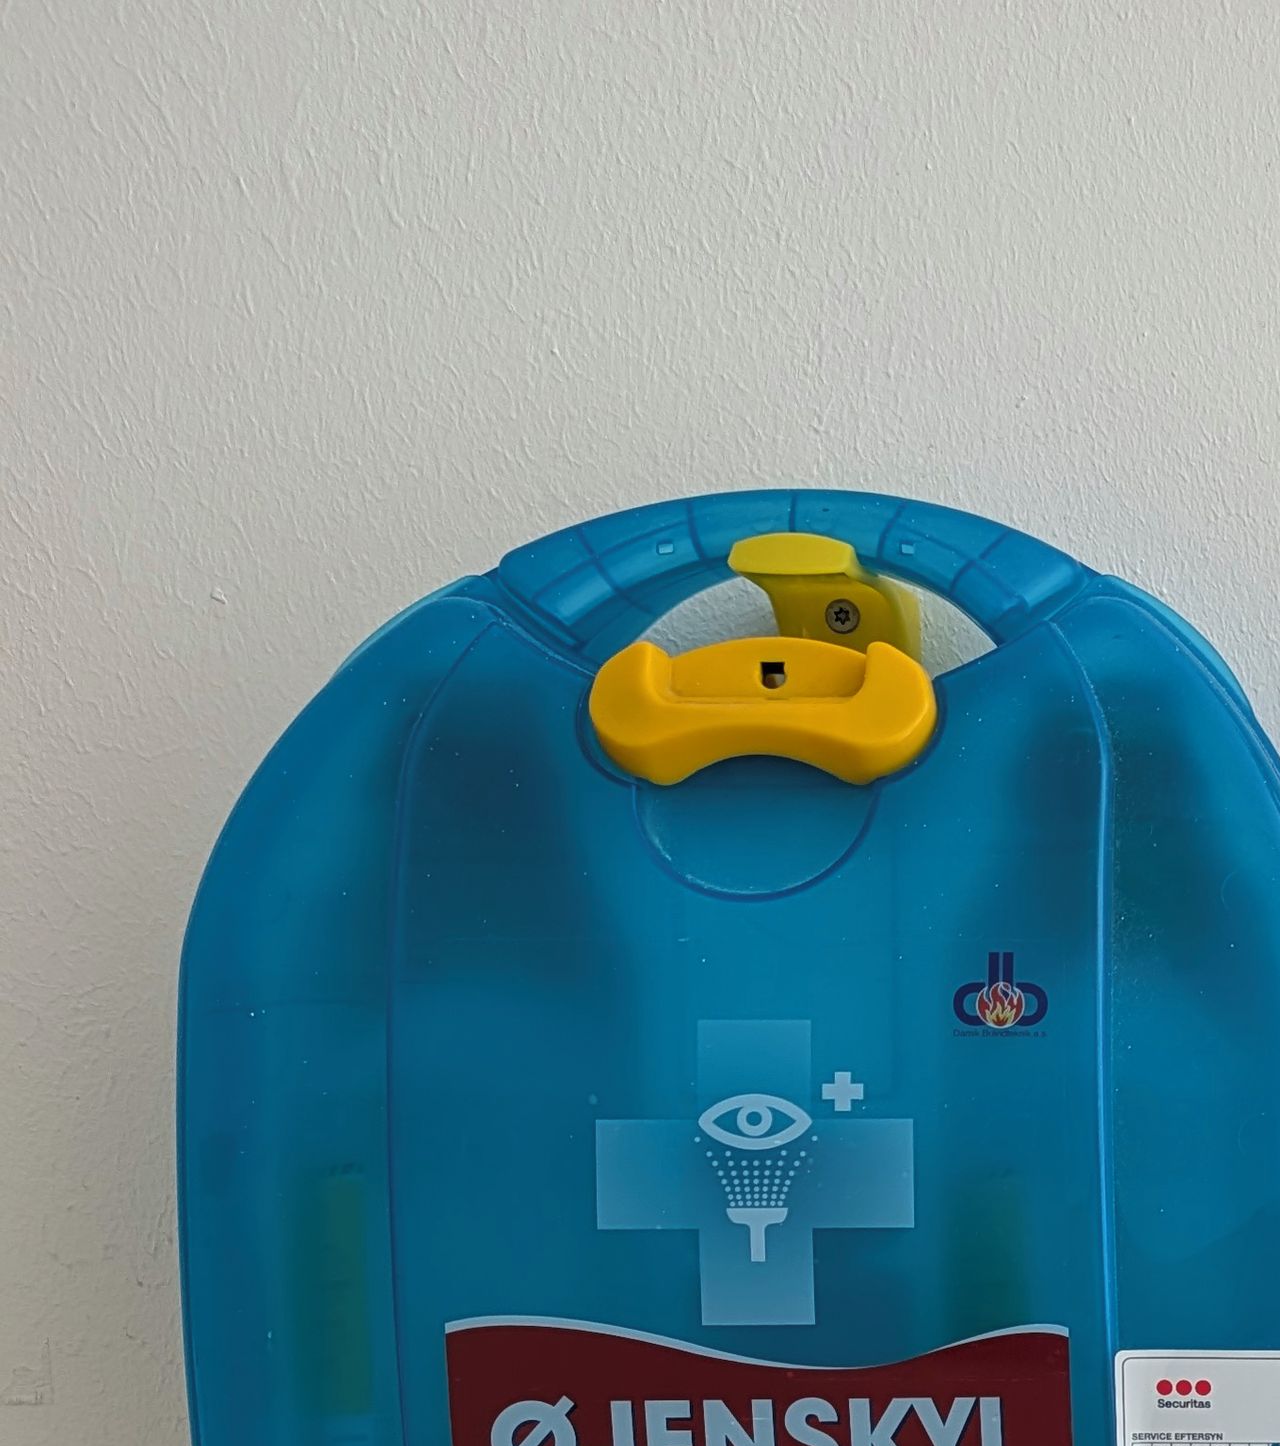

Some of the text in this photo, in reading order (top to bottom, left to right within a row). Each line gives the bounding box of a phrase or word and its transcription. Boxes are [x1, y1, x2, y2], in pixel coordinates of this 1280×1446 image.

[1157, 1399, 1211, 1409] Securitas
[1131, 1432, 1223, 1441] SERVICE EFTERSYN
